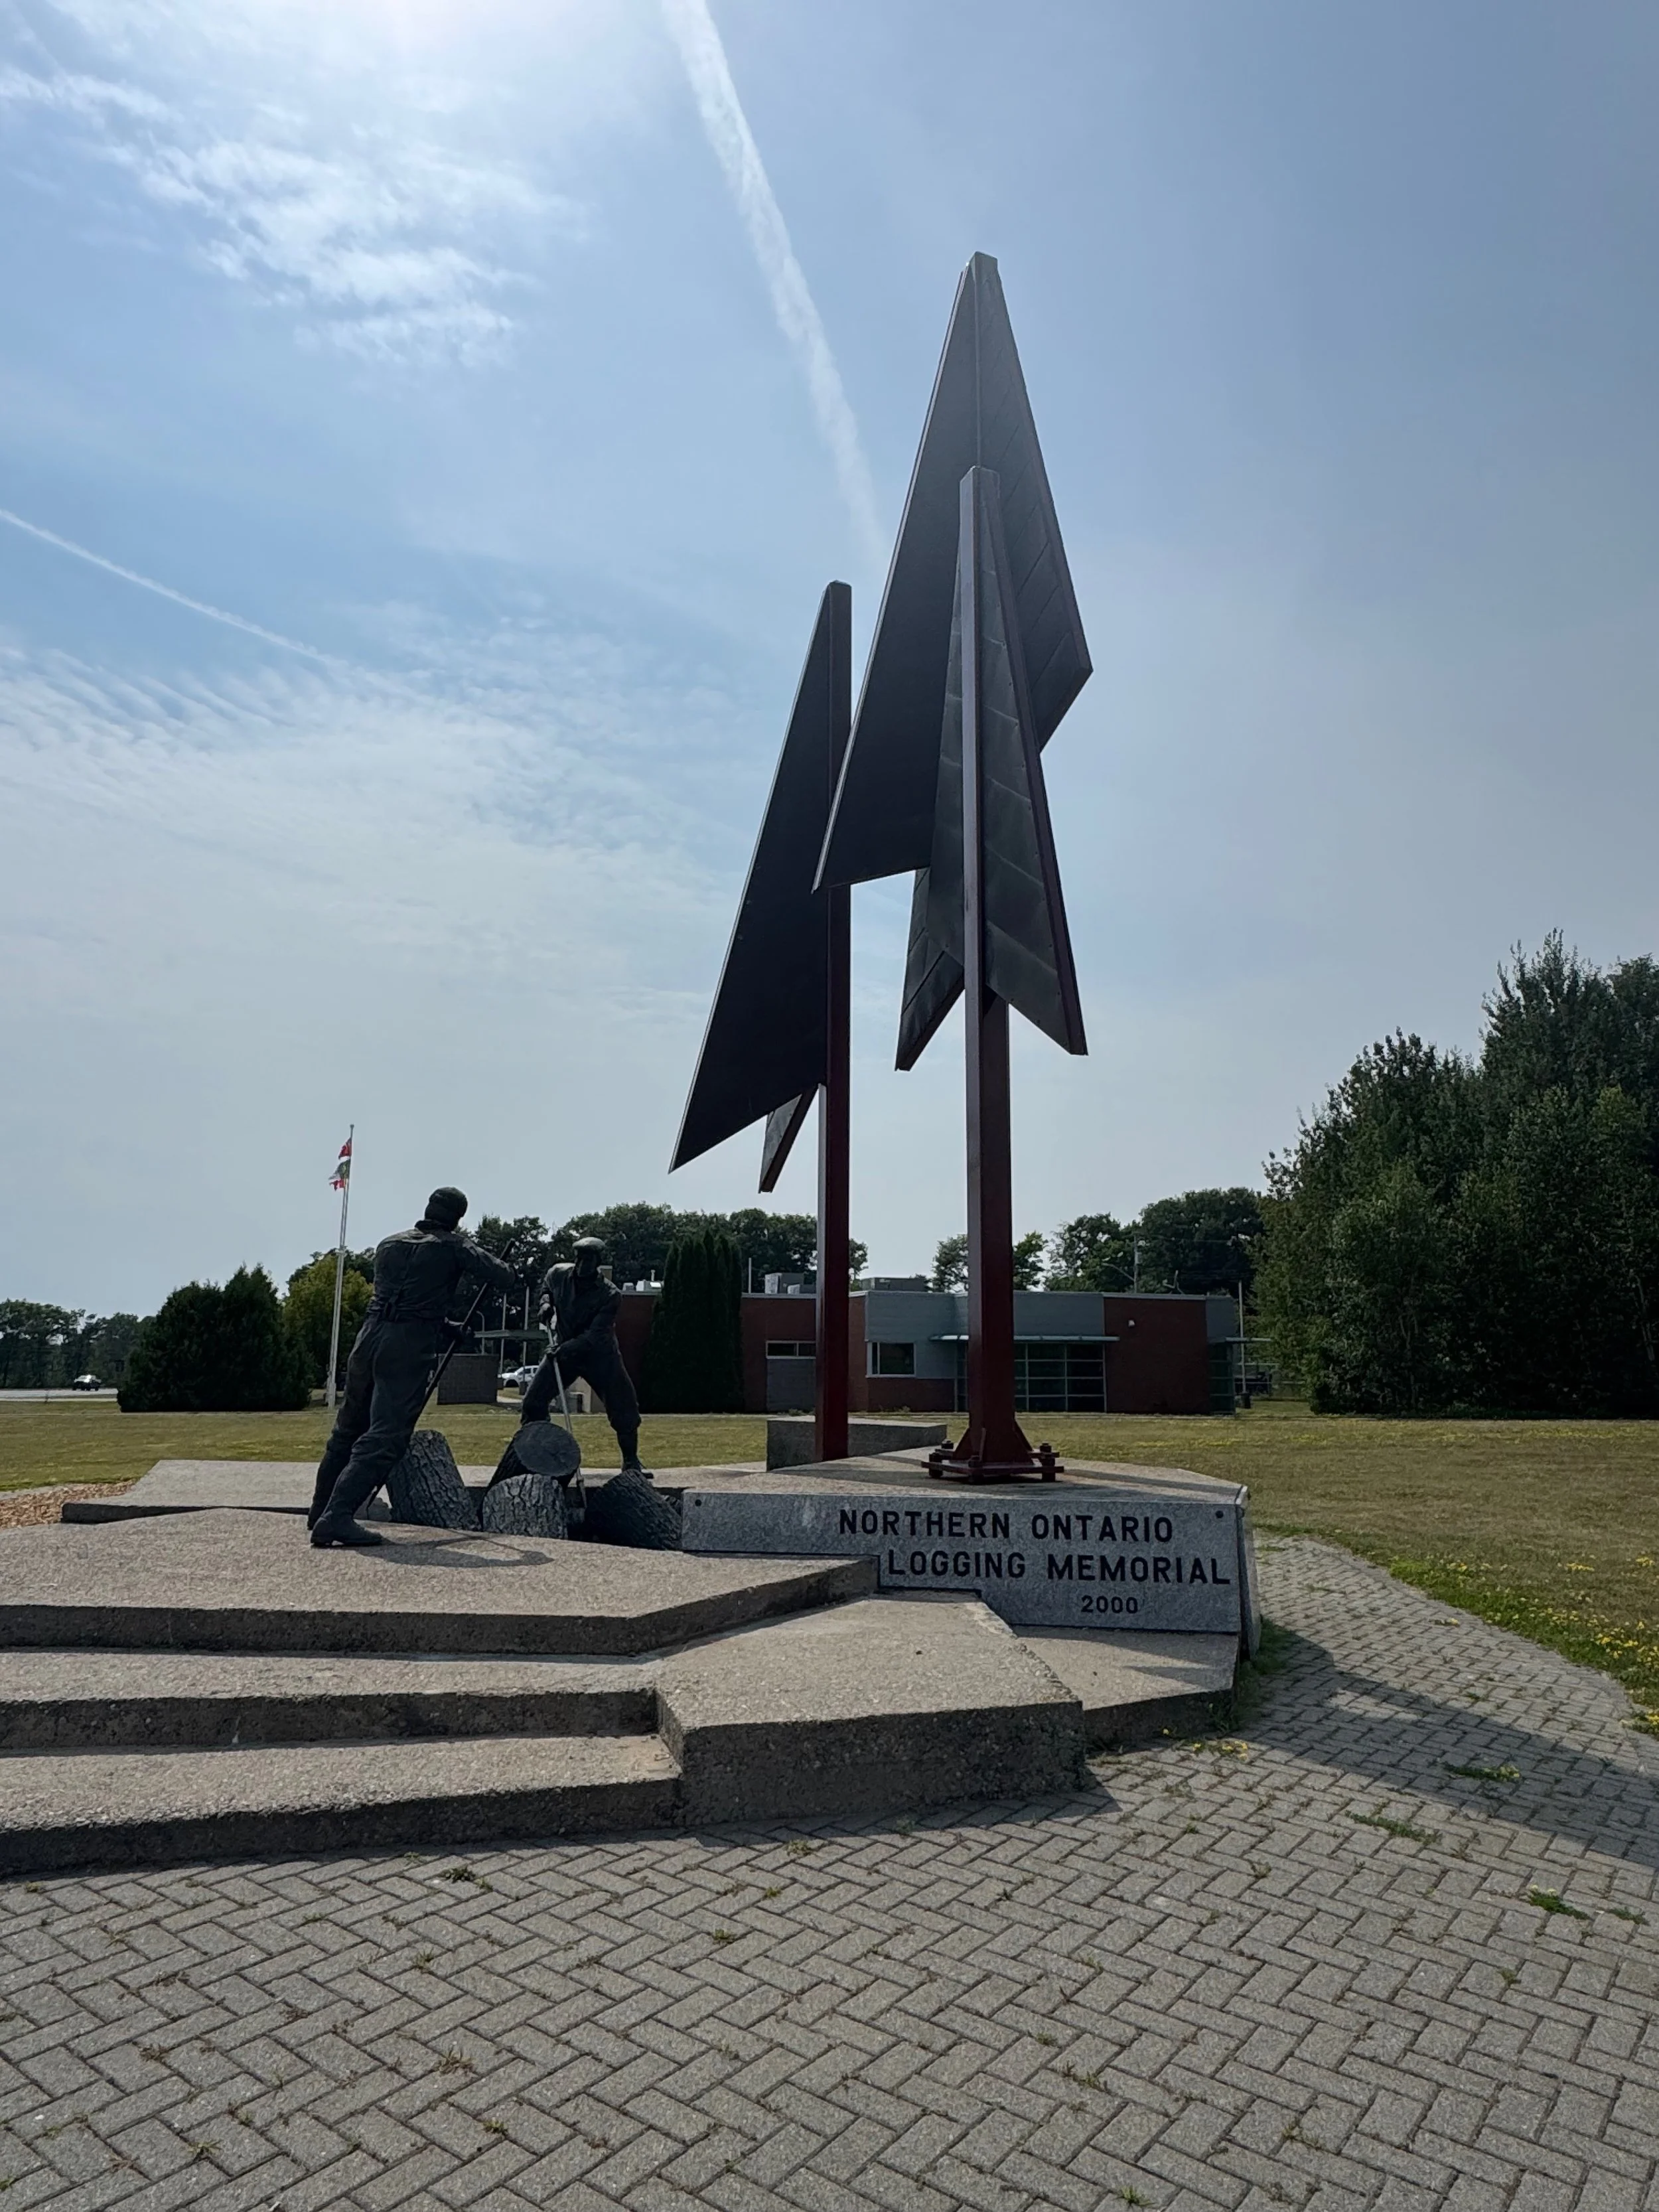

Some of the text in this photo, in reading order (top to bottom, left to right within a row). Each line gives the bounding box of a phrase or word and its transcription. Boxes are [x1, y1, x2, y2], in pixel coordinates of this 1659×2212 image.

[839, 1509, 1173, 1543] NORTHERN ONTARIO
[888, 1550, 1230, 1585] LOGGING MEMORIAL
[1081, 1595, 1139, 1614] 2000
